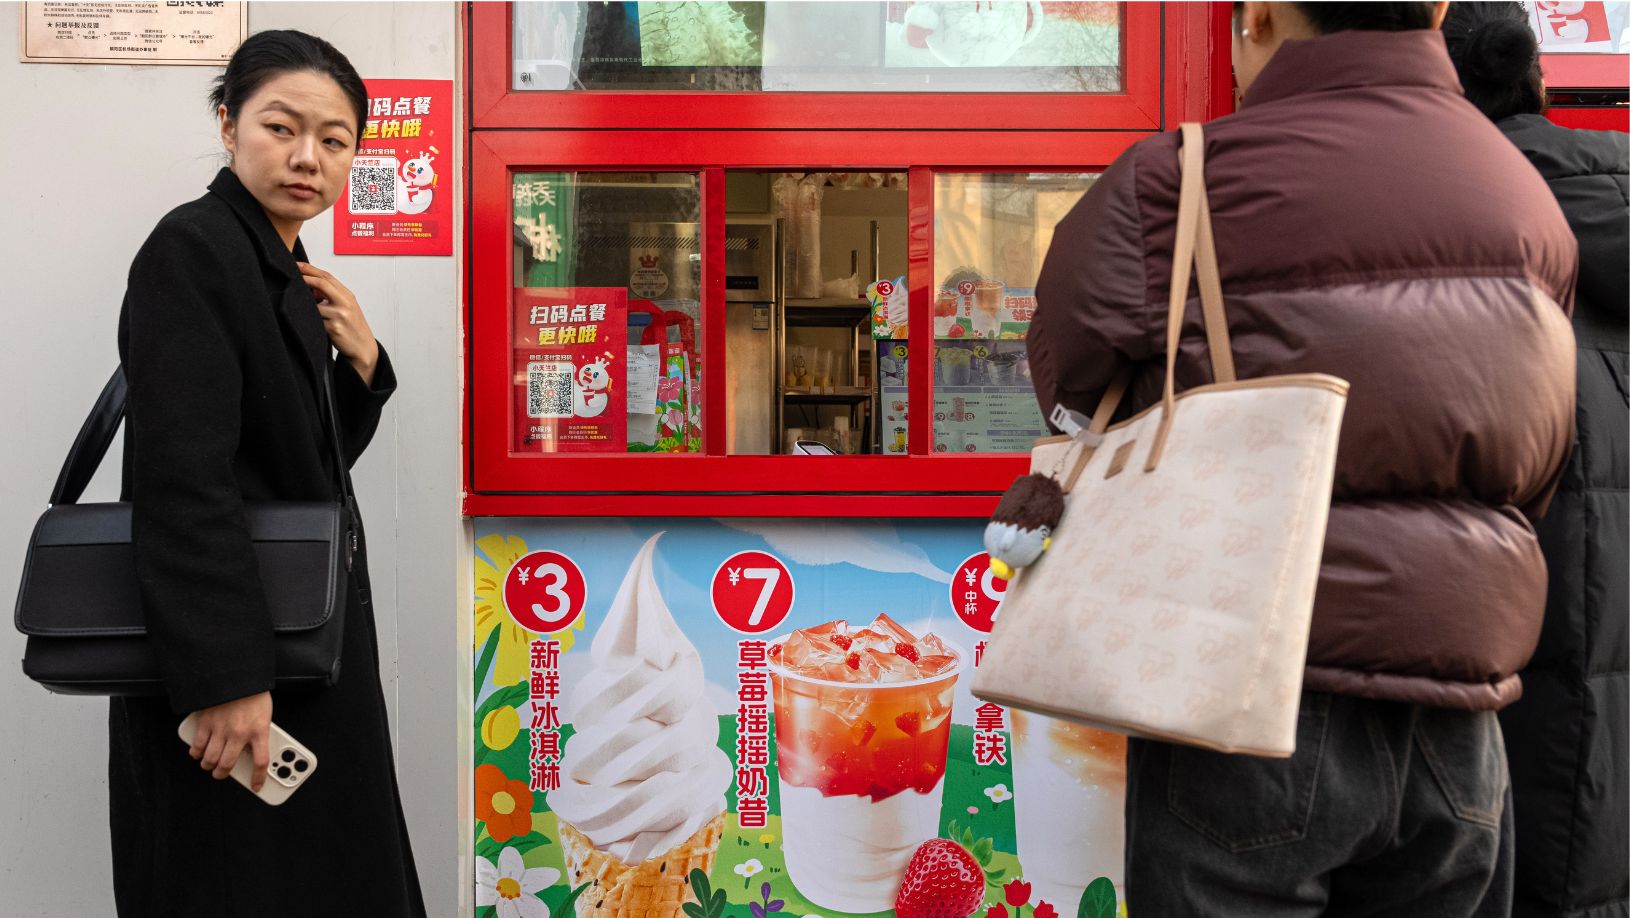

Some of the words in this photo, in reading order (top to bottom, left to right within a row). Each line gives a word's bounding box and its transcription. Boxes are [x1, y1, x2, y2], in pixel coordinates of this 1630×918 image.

[367, 97, 432, 117] 码点餐
[361, 118, 422, 139] 更快哦
[529, 303, 607, 324] 扫码点餐
[538, 325, 598, 346] 更快哦
[517, 562, 572, 623] ¥3
[728, 567, 781, 626] ¥7
[964, 591, 978, 615] 中杯
[529, 640, 561, 791] 新鲜冰淇淋
[737, 640, 769, 828] 草莓摇摇奶昔
